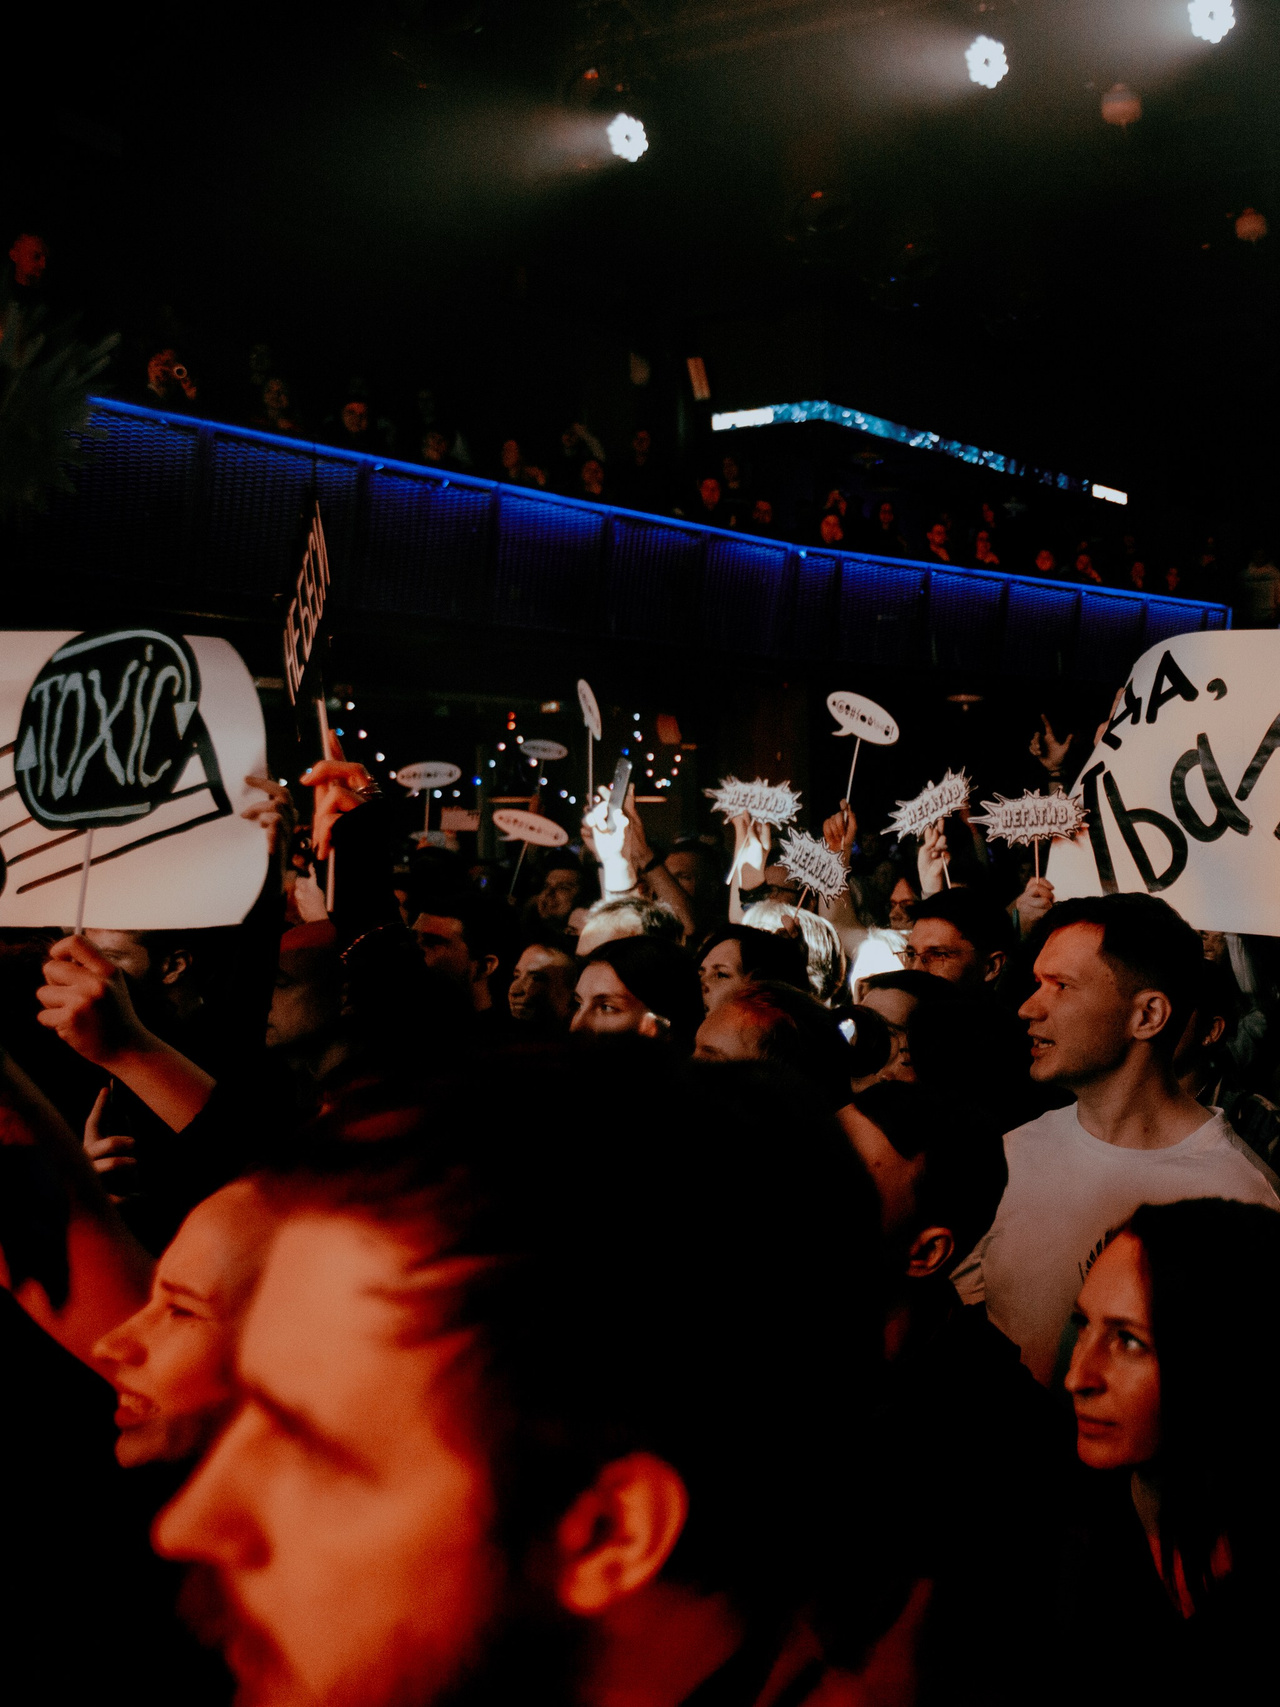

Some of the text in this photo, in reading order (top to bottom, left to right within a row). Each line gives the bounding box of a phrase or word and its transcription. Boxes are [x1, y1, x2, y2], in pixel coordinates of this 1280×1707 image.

[729, 789, 787, 814] НЕГАТИВ
[906, 784, 962, 826] НЕГАТИВ
[1002, 806, 1069, 828] НЕГАТИВ
[791, 846, 840, 890] НЕГАТИВ
